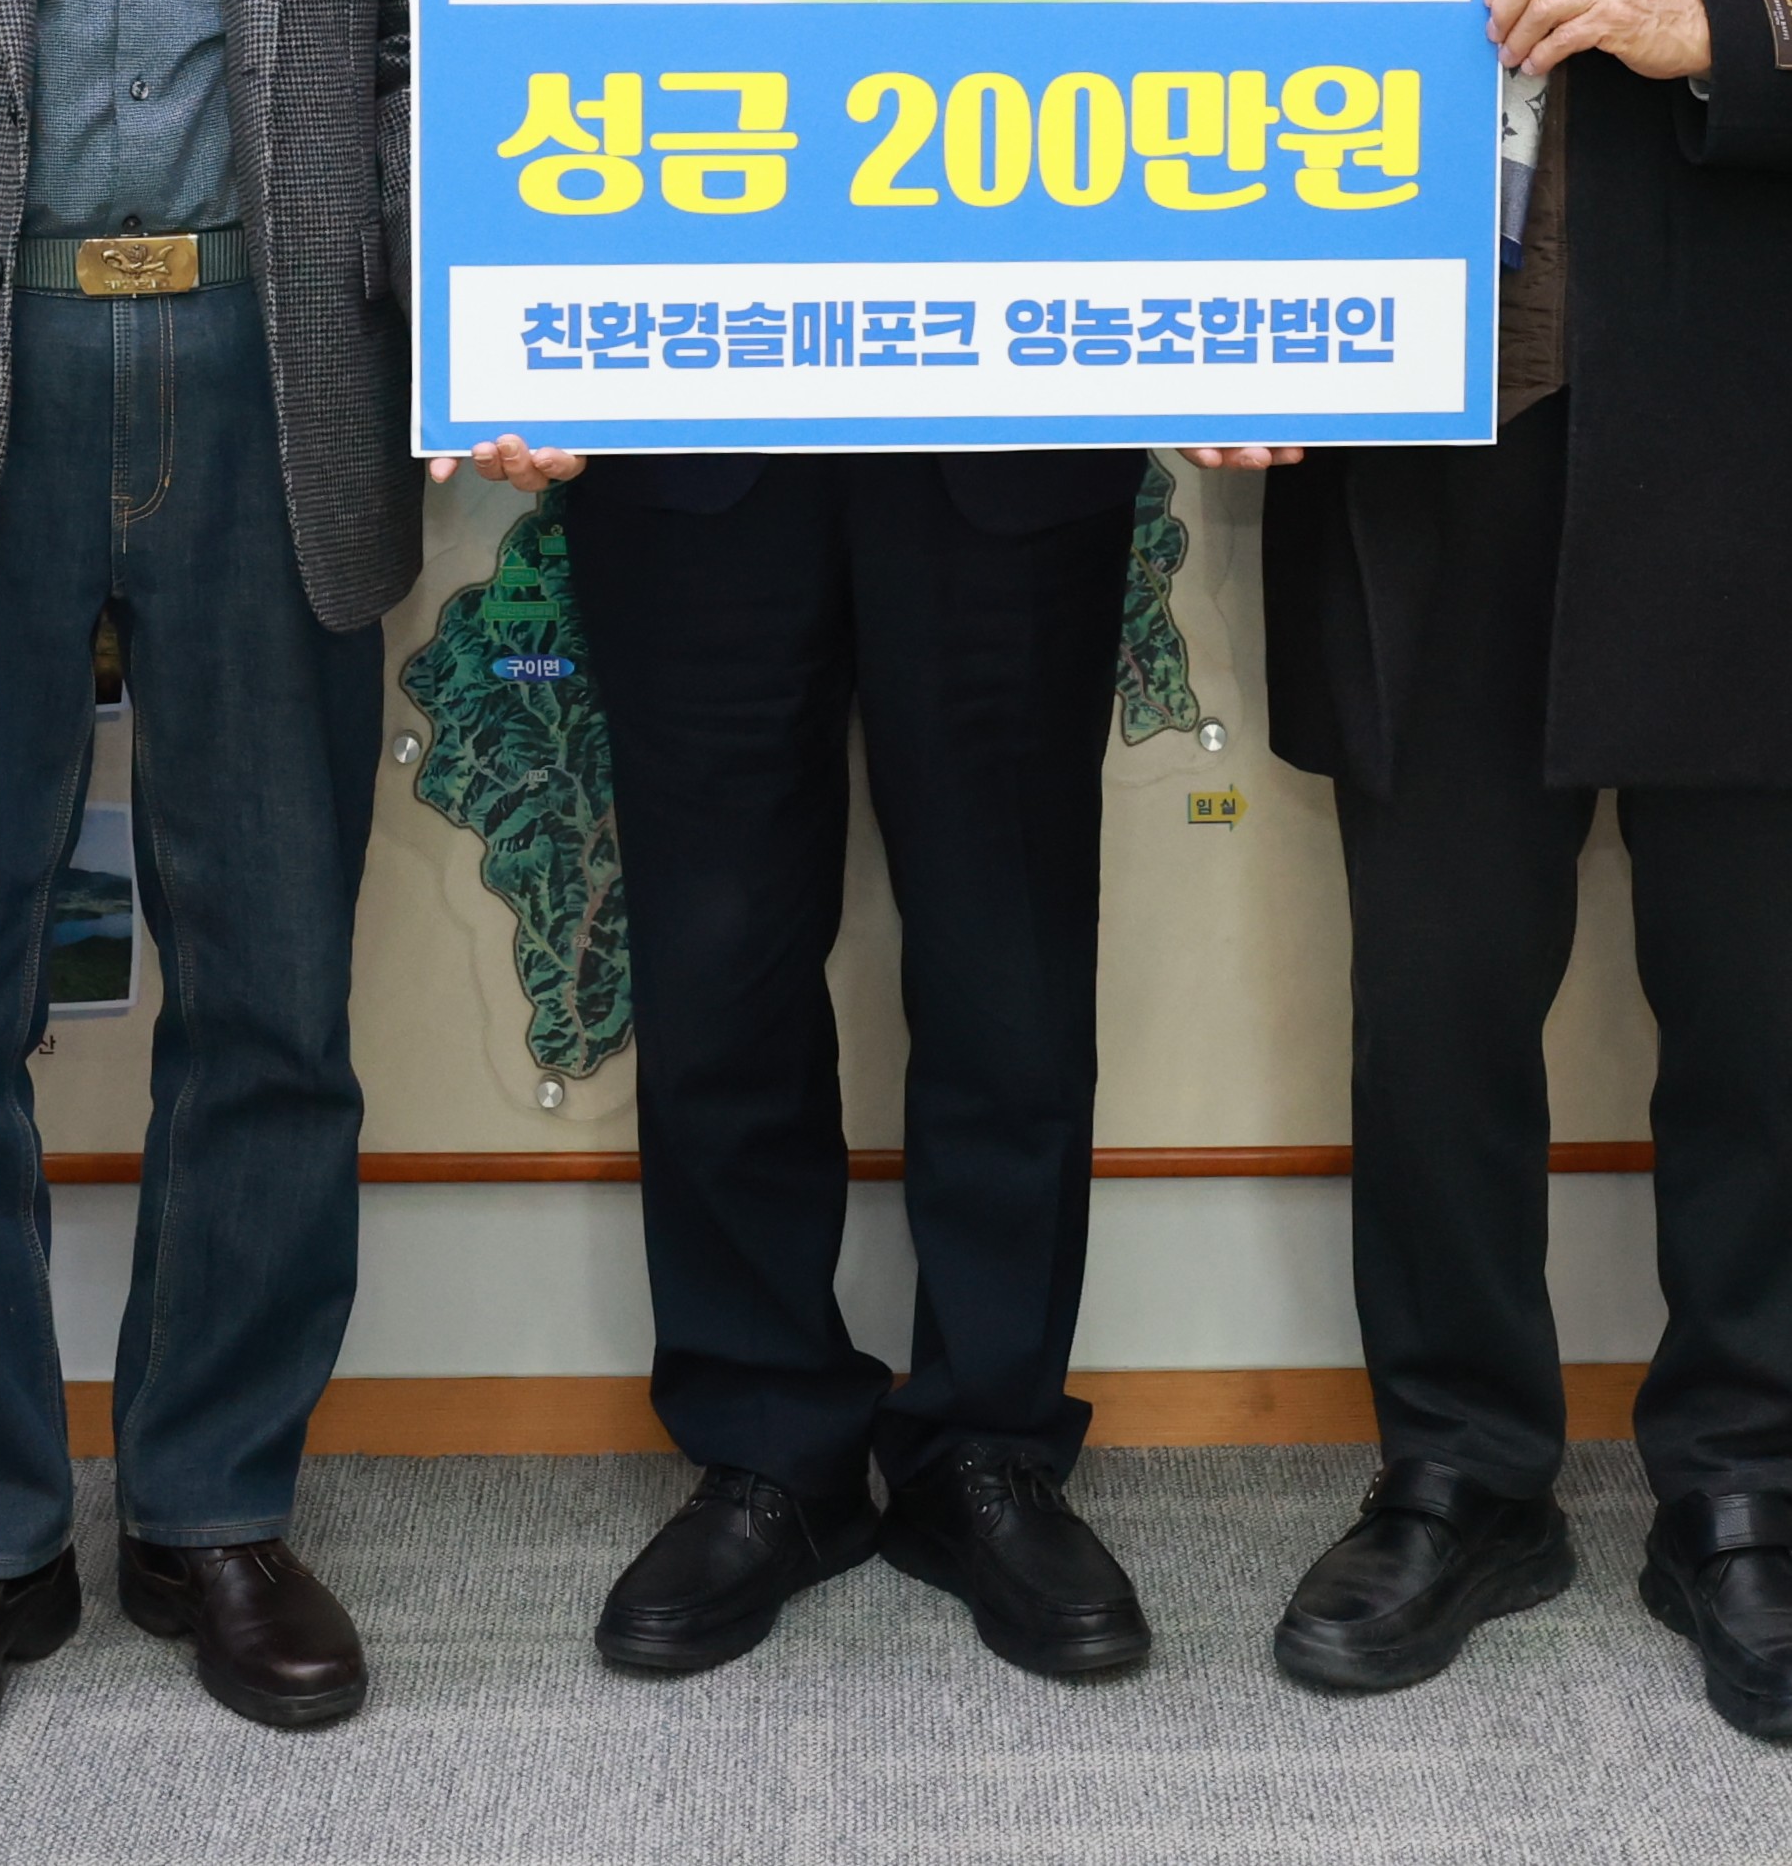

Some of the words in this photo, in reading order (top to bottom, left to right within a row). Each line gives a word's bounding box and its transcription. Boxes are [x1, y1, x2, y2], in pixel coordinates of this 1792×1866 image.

[496, 70, 799, 216] 성금
[845, 65, 1421, 213] 200만원
[520, 300, 980, 370] 친환경솔매포크
[1006, 296, 1396, 369] 영농조합법인
[507, 660, 560, 677] 구이면
